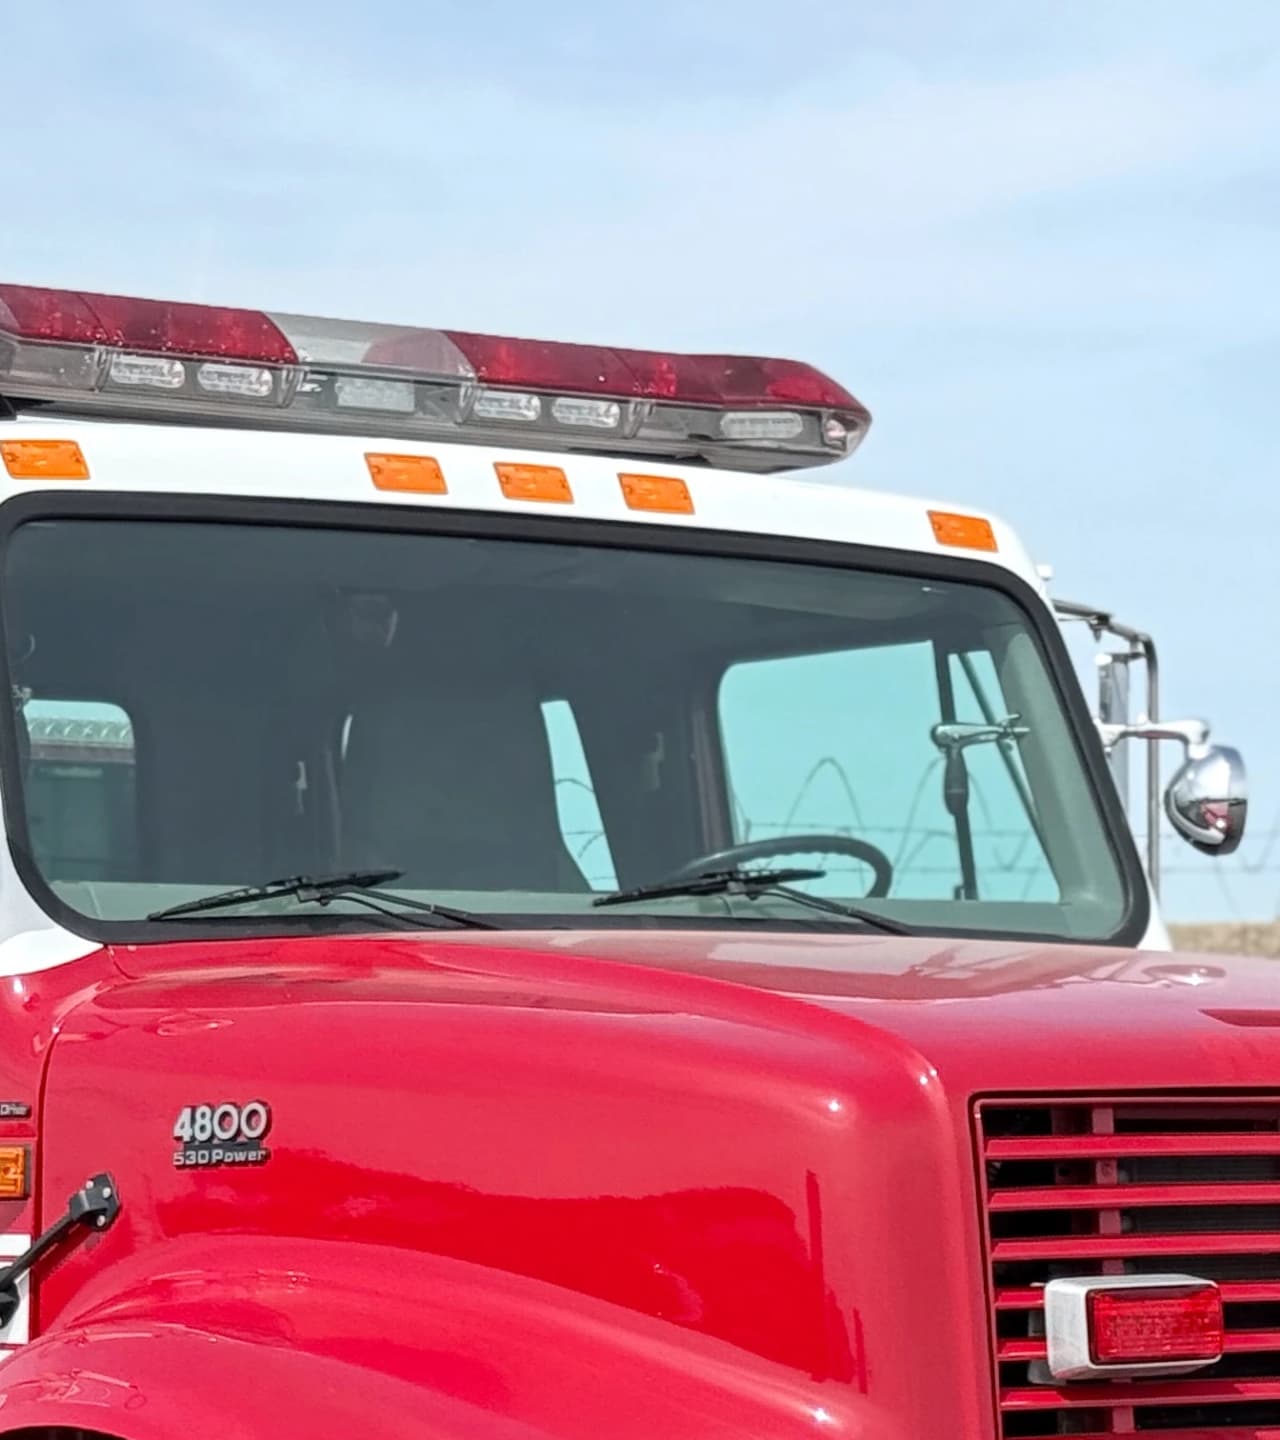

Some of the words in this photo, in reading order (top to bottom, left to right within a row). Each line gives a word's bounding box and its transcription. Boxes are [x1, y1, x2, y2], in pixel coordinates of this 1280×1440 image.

[173, 1101, 268, 1142] 4800
[173, 1150, 210, 1166] 530
[211, 1148, 267, 1164] Power
